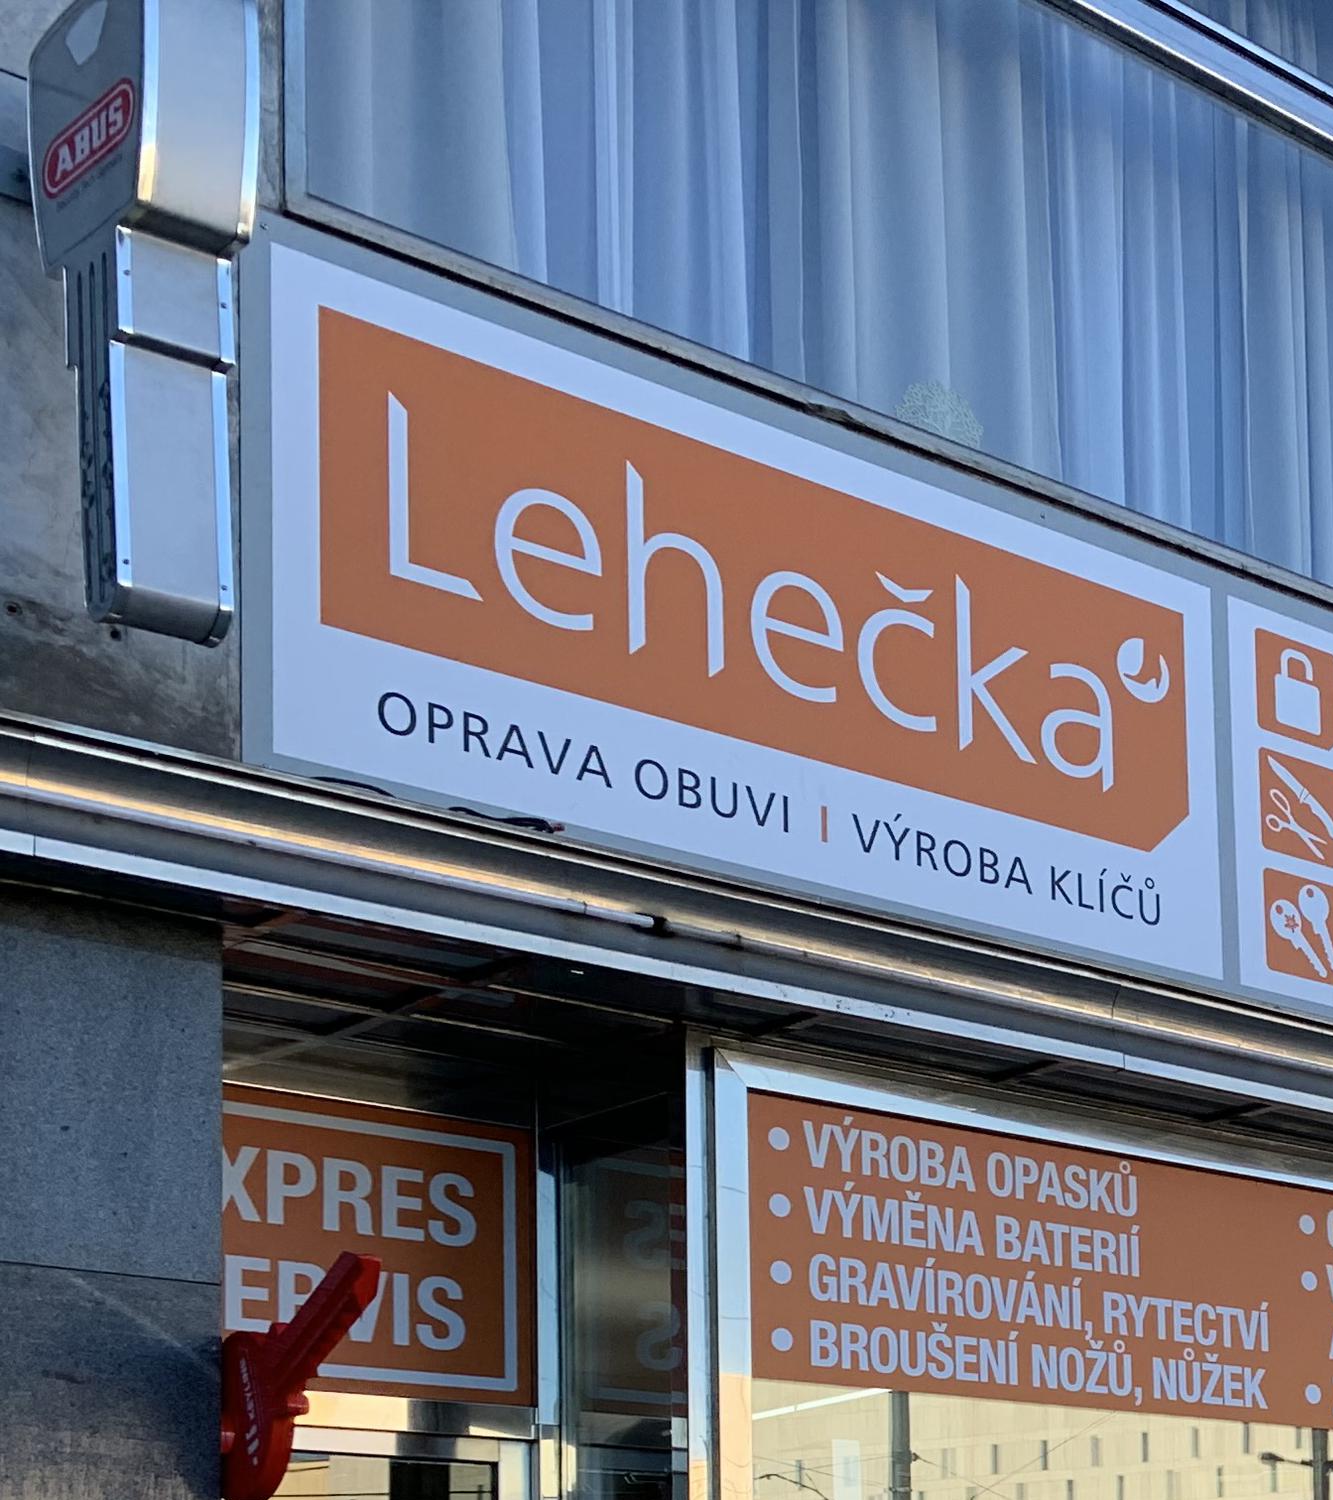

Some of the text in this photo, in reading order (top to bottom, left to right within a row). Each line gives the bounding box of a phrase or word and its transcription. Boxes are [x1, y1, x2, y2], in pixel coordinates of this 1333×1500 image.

[55, 97, 123, 181] ABUS
[388, 391, 1116, 794] Lehečka
[377, 690, 1162, 927] OPRAVA OBUVI VÝROBA KLÍČŮ
[222, 1145, 477, 1247] XPRES
[802, 1117, 1138, 1218] VÝROBA OPASKŮ
[803, 1181, 1141, 1277] VÝMĚNA BATERIÍ
[224, 1254, 466, 1351] ERVIS
[809, 1253, 1269, 1352] GRAVÍROVÁNÍ, RYTECTVÍ
[810, 1319, 1269, 1410] BROUŠENÍ NOŽŮ, NŮŽEK
